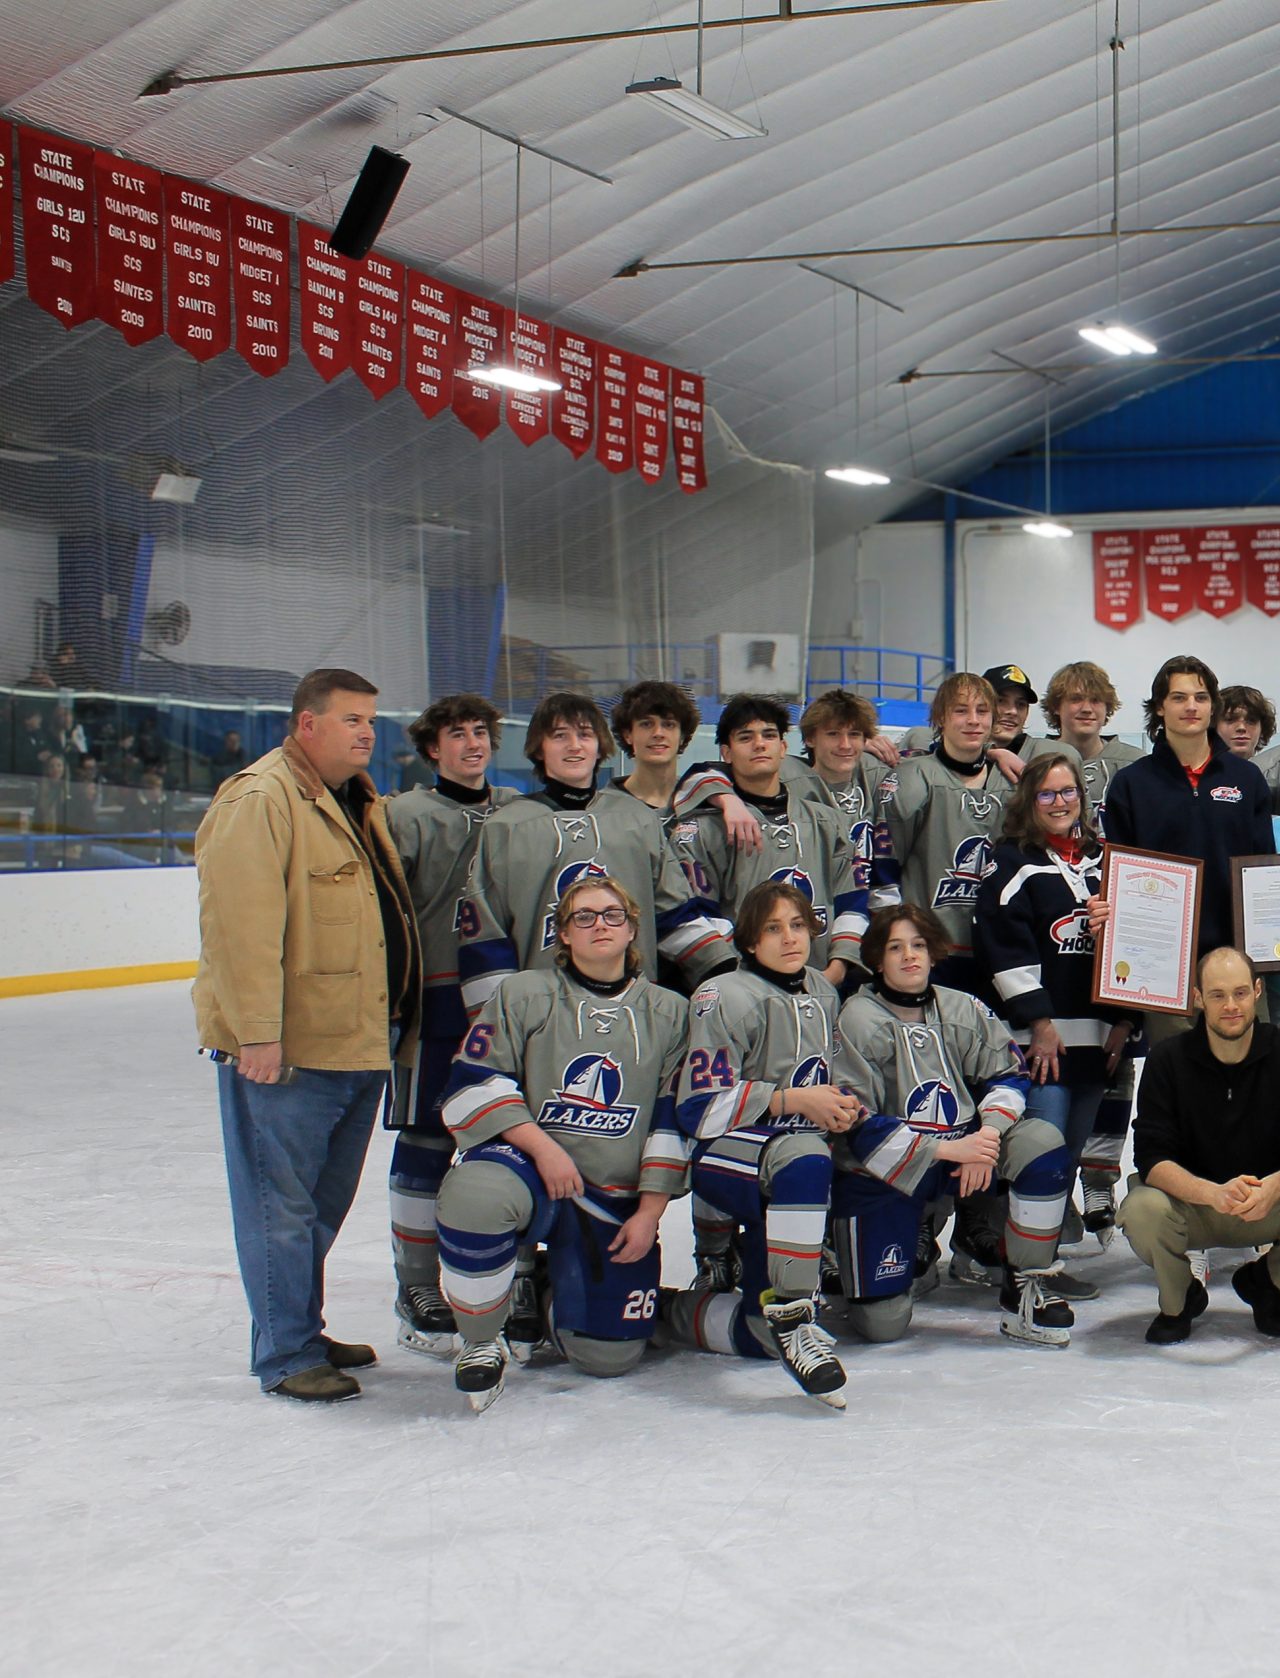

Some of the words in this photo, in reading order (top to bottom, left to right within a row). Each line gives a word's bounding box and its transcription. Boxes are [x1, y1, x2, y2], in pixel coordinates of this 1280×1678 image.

[41, 149, 73, 170] STATE
[34, 164, 84, 191] CHAMPIONS
[112, 172, 145, 194] STATE
[37, 197, 64, 217] GIRLS
[68, 207, 85, 224] 12U
[105, 197, 158, 225] CHAMPIONS
[181, 191, 211, 212] STATE
[52, 225, 70, 242] SCS
[170, 214, 222, 242] CHAMPIONS
[246, 214, 274, 234] STATE
[108, 224, 136, 244] GIRLS
[139, 233, 156, 250] 19U
[173, 242, 202, 261] GIRLS
[206, 251, 219, 267] 19U
[238, 237, 283, 263] CHAMPIONS
[124, 254, 142, 272] SCS
[240, 262, 273, 284] MIDGET
[306, 256, 347, 282] CHAMPIONS
[367, 259, 392, 280] STATE
[188, 271, 210, 287] SCS
[358, 276, 399, 303] CHAMPIONS
[113, 279, 153, 302] SAINTES
[252, 290, 272, 306] SCS
[307, 279, 336, 301] BANTAM
[338, 291, 345, 304] B
[420, 284, 444, 303] STATE
[121, 309, 144, 327] 2009
[317, 303, 334, 320] SCS
[358, 299, 381, 318] GIRLS
[411, 298, 451, 325] CHAMPIONS
[470, 305, 490, 322] STATE
[188, 324, 212, 341] 2010
[246, 314, 279, 334] SAINTS
[312, 321, 340, 342] BRUINS
[369, 322, 386, 339] SCS
[413, 323, 439, 343] MIDGET
[441, 333, 448, 346] A
[461, 315, 498, 338] CHAMPIONS
[518, 318, 538, 336] STATE
[252, 342, 278, 358] 2010
[361, 339, 393, 363] SAINTES
[422, 344, 438, 360] SCS
[510, 331, 547, 354] CHAMPIONS
[470, 348, 486, 362] SCS
[367, 362, 386, 379] 2013
[416, 361, 442, 381] SAINTS
[420, 381, 438, 398] 2013
[938, 882, 979, 899] LAK
[689, 1049, 735, 1092] 24
[539, 1106, 631, 1133] LAKERS
[622, 1288, 656, 1320] 26
